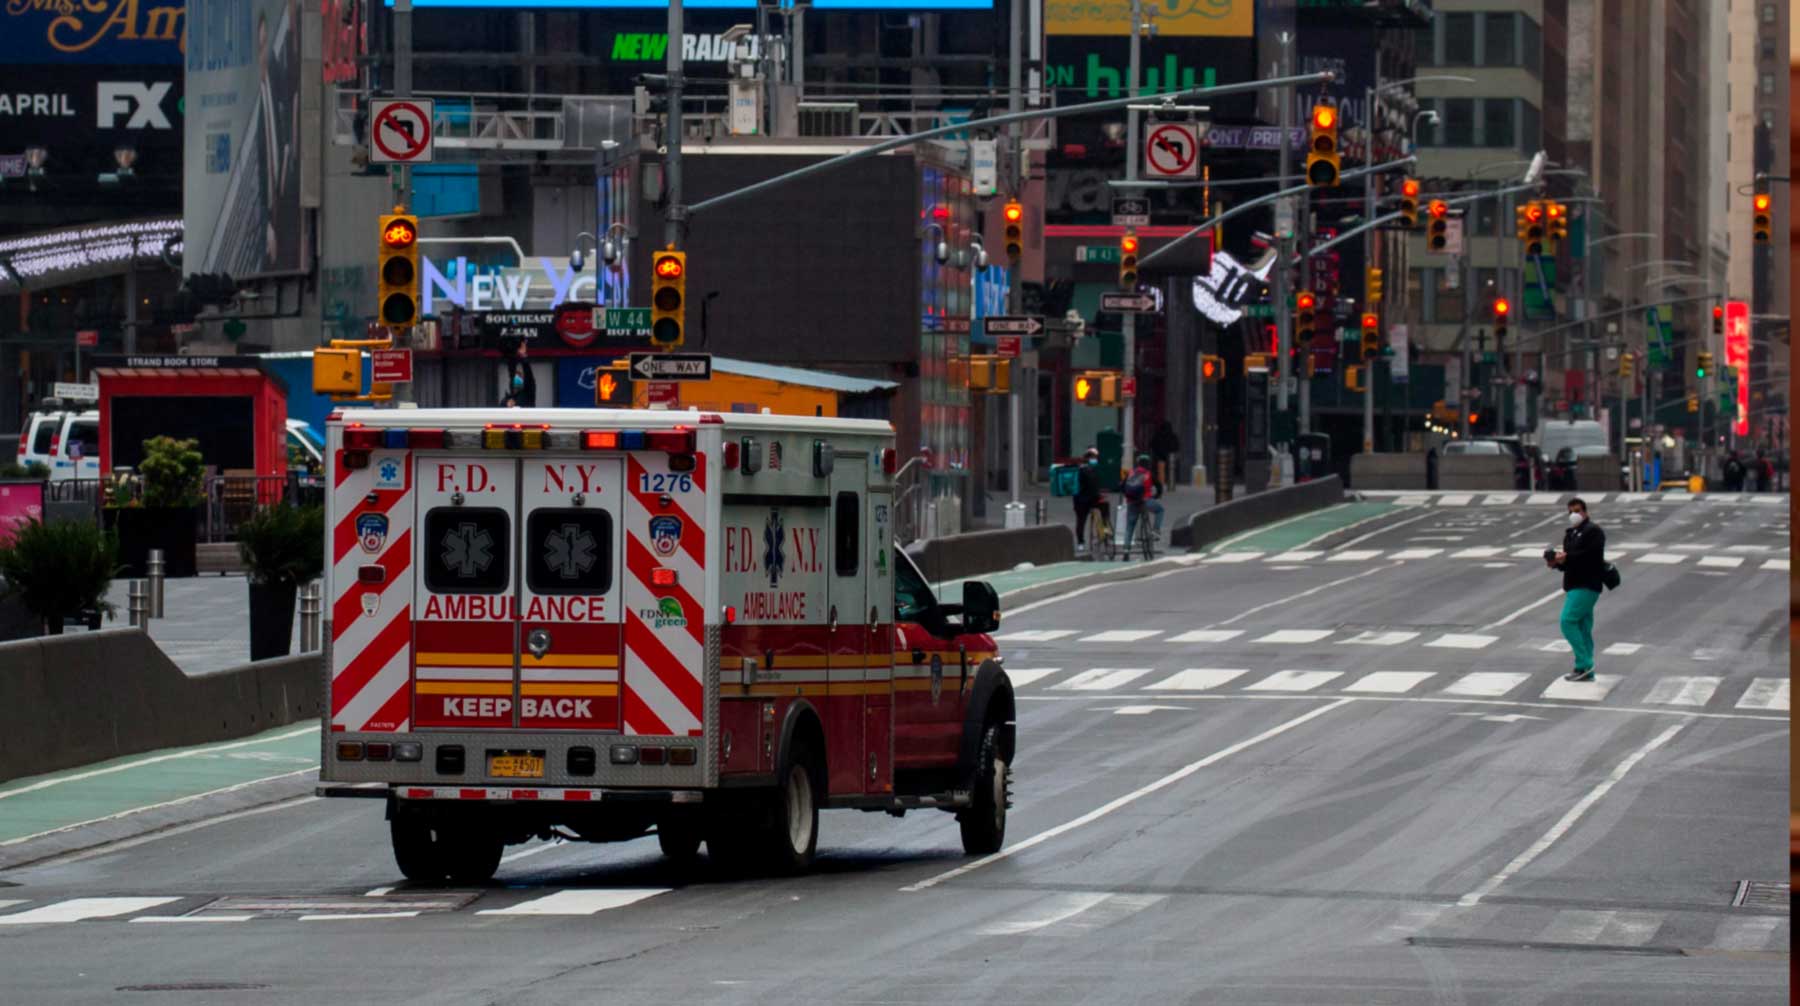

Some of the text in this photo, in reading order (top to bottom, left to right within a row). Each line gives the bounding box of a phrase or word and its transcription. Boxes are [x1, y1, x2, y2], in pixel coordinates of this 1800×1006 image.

[48, 0, 185, 54] Am
[611, 34, 668, 60] NEW
[1087, 54, 1216, 98] hulu
[0, 94, 76, 116] APRIL
[97, 82, 173, 128] FX
[1207, 128, 1299, 147] ONT PRIE
[485, 313, 554, 325] SOUTHEAST
[608, 312, 644, 327] W 44
[127, 357, 218, 366] STRAND BOOK STORE
[642, 361, 701, 372] ONE WAY
[437, 463, 602, 493] F.D. N.Y.
[639, 473, 692, 494] 1276
[725, 527, 823, 574] F.D. N.Y.
[424, 595, 605, 622] AMBULANCE
[640, 609, 671, 619] FDNY
[743, 592, 806, 620] AMBULANCE
[655, 617, 687, 629] green
[443, 697, 593, 719] KEEP BACK
